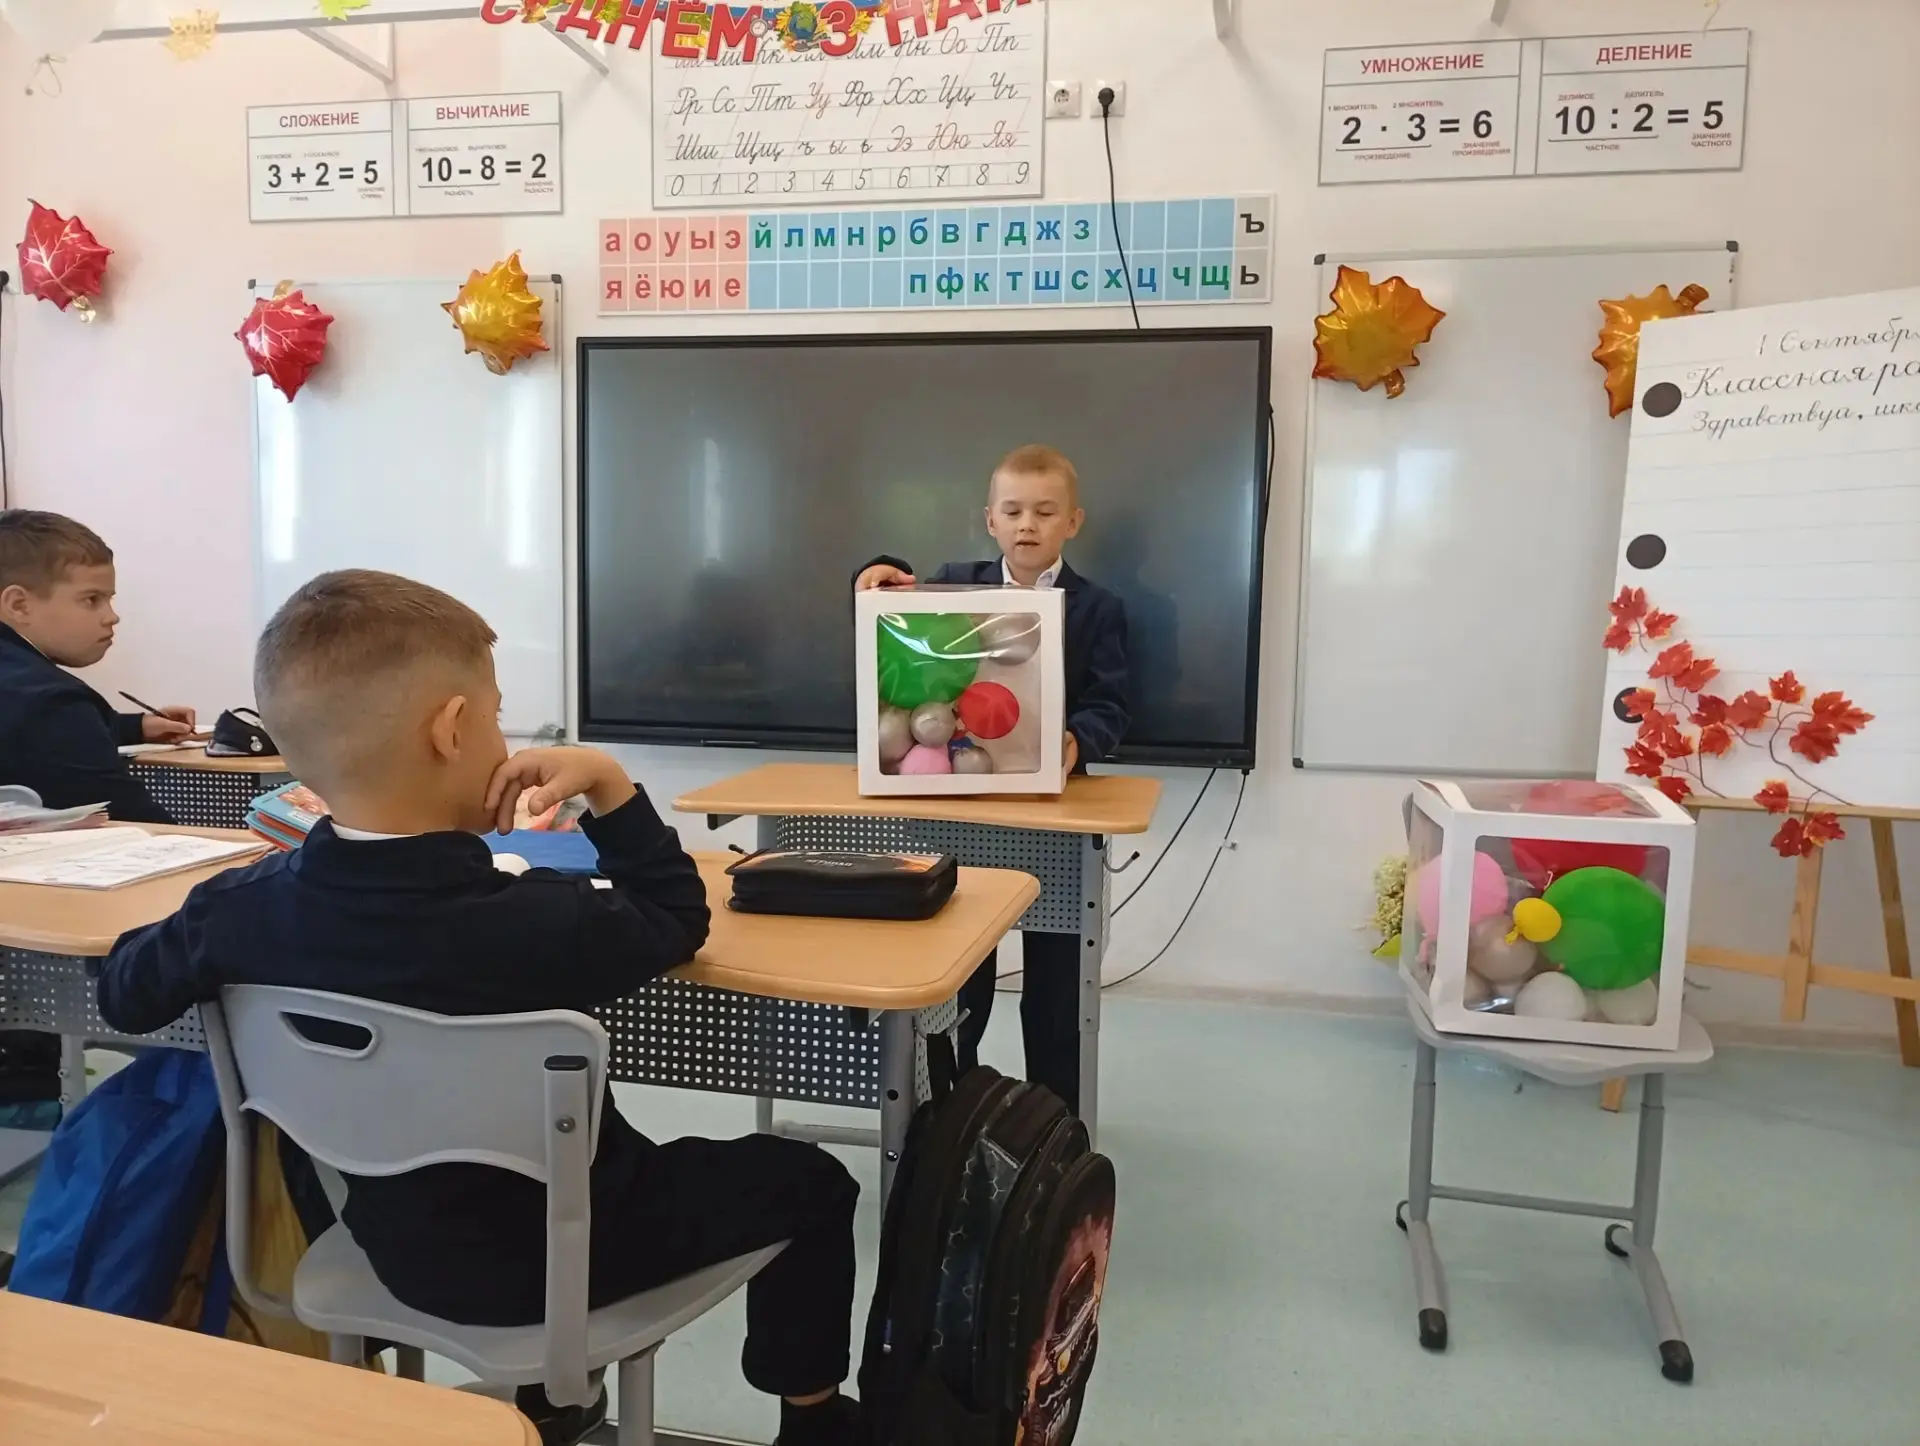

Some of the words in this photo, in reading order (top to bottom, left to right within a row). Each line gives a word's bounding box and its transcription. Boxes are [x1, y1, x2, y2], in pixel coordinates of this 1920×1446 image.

[819, 0, 1031, 56] ЗНА
[1361, 54, 1484, 74] УМНОЖЕНИЕ
[1596, 43, 1692, 65] ДЕЛЕНИЕ
[436, 103, 530, 120] ВЫЧИТАНИЕ
[674, 86, 703, 126] Рр
[712, 85, 736, 113] Сс
[744, 83, 796, 112] Тт
[805, 81, 831, 119] Уу
[839, 80, 874, 117] Фф
[883, 76, 928, 105] Хх
[938, 74, 976, 109] Цц
[990, 72, 1018, 99] Чч
[279, 112, 360, 128] СЛОЖЕНИЕ
[1555, 105, 1595, 135] 10
[1633, 103, 1653, 132] 2
[1702, 100, 1723, 130] 5
[675, 133, 719, 160] Шш
[735, 131, 784, 164] Щщ
[798, 141, 815, 156] ъ
[830, 140, 847, 155] ы
[860, 139, 873, 153] ь
[887, 125, 913, 151] Ээ
[928, 122, 971, 150] Юю
[982, 120, 1018, 148] Яя
[268, 164, 282, 188] 3
[315, 162, 329, 186] 2
[364, 160, 378, 184] 5
[422, 157, 452, 182] 10
[480, 155, 495, 180] 8
[531, 153, 546, 178] 2
[670, 175, 684, 196] 0
[712, 173, 721, 193] 1
[744, 172, 758, 194] 2
[783, 170, 796, 192] 3
[821, 170, 834, 191] 4
[855, 168, 872, 190] 5
[897, 167, 911, 188] 6
[935, 165, 949, 187] 7
[976, 163, 989, 186] 8
[1016, 161, 1029, 184] 9
[605, 232, 620, 252] а
[634, 232, 651, 251] о
[664, 231, 681, 257] у
[691, 230, 714, 249] ы
[725, 229, 741, 249] э
[755, 221, 771, 248] й
[784, 227, 803, 248] л
[814, 227, 835, 247] м
[848, 226, 864, 246] н
[878, 225, 896, 252] р
[909, 217, 928, 244] б
[942, 223, 960, 243] в
[976, 222, 989, 242] г
[1004, 221, 1027, 246] д
[1036, 220, 1061, 240] ж
[1073, 219, 1090, 240] з
[606, 279, 622, 299] я
[635, 274, 651, 299] ё
[660, 278, 684, 298] ю
[694, 278, 711, 298] и
[724, 277, 741, 297] е
[910, 274, 926, 293] п
[936, 267, 964, 300] ф
[974, 272, 989, 292] к
[1006, 271, 1023, 291] т
[1035, 270, 1060, 290] ш
[1071, 269, 1089, 290] с
[1103, 268, 1123, 289] х
[1137, 267, 1157, 292] ц
[1172, 266, 1191, 286] ч
[1201, 265, 1229, 290] щ
[1240, 265, 1260, 285] ь
[1683, 366, 1871, 400] Классная
